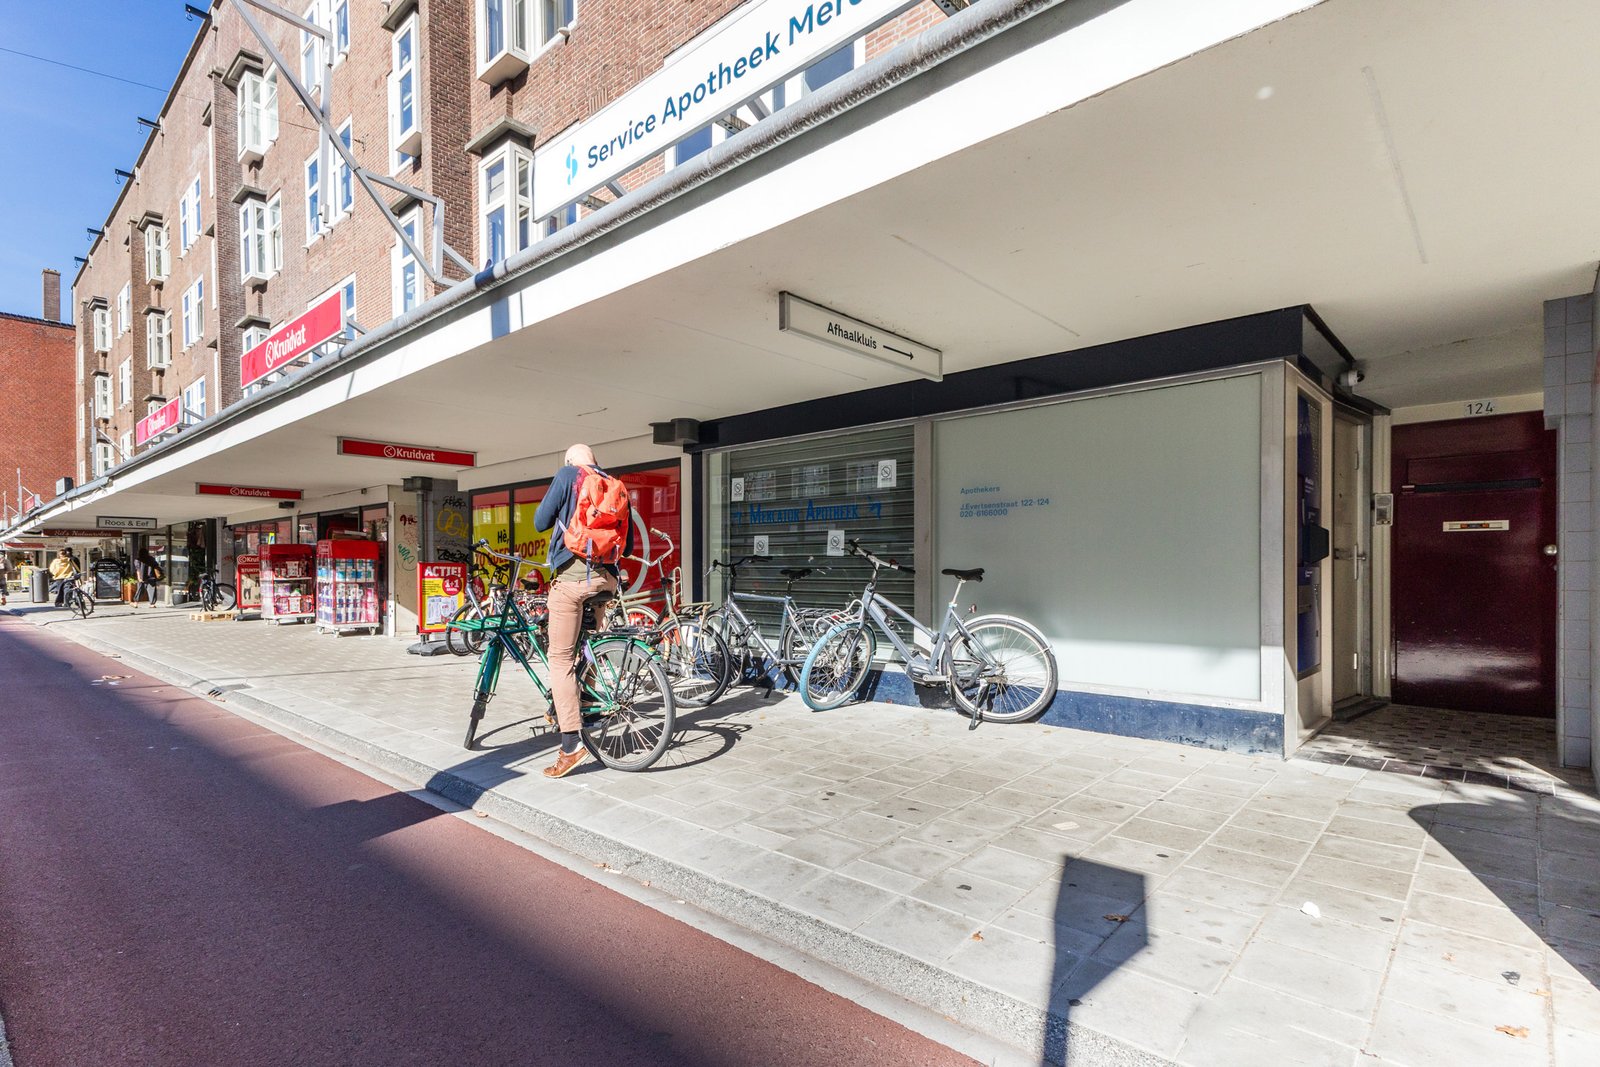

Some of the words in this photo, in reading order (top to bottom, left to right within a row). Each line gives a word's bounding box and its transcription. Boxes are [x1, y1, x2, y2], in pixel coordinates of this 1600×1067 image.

[587, 112, 657, 169] Service
[661, 31, 781, 121] Apotheek
[788, 0, 861, 46] Mer
[827, 321, 878, 350] Afhaalkluis
[272, 323, 307, 362] Kruidvat
[1466, 401, 1494, 415] 124
[396, 447, 436, 461] Kruidvat
[239, 488, 271, 498] Kruidvat
[960, 486, 1001, 495] Apothekers
[960, 500, 1019, 511] J.Evertsenstraat
[960, 508, 1008, 518] 020-6166000
[127, 519, 134, 527] &
[424, 565, 463, 578] ACTIE!
[444, 579, 460, 588] 1+1
